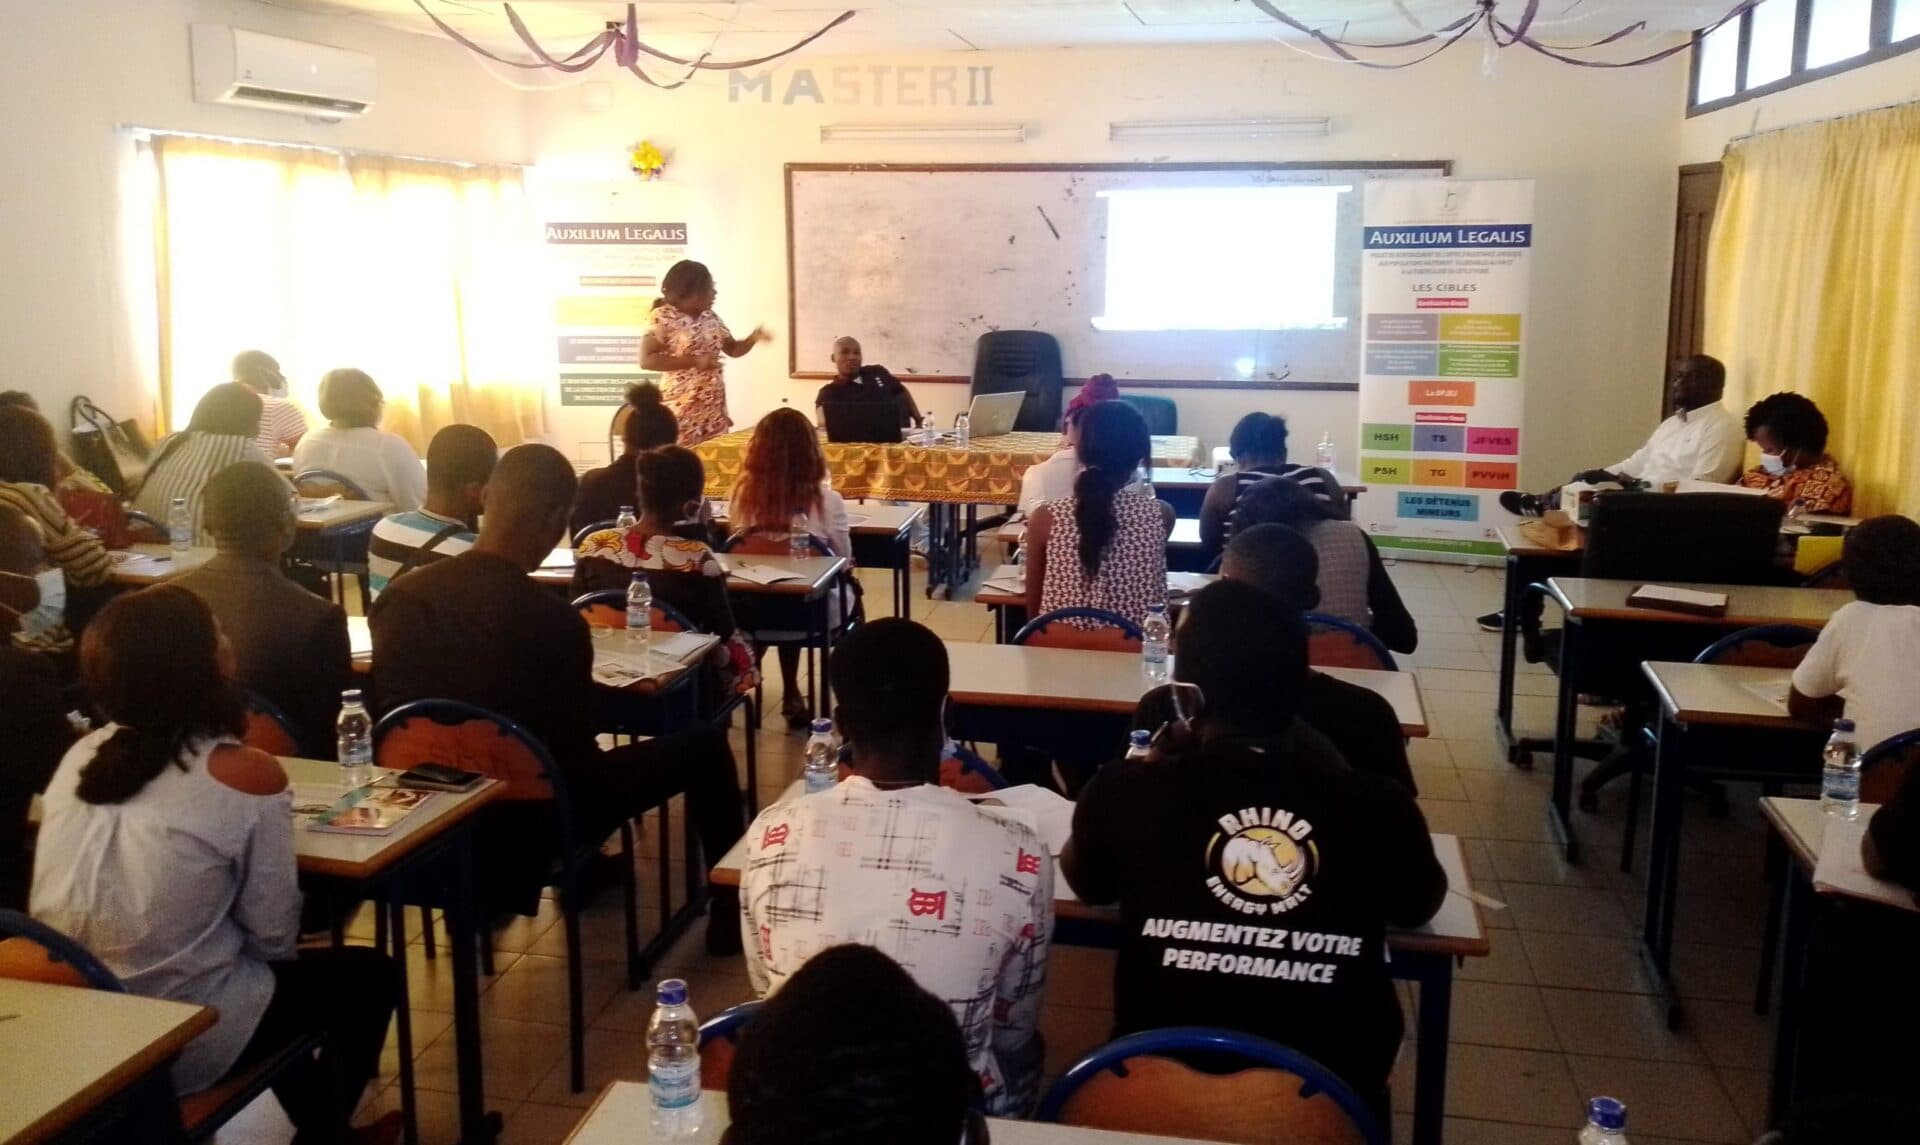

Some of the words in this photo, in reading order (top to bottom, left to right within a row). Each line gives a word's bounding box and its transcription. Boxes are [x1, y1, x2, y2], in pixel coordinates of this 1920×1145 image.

[728, 65, 957, 106] MASTER
[545, 227, 620, 240] AUXILIUM
[624, 227, 685, 240] LEGALIS
[1369, 230, 1452, 245] AUXILIUM
[1457, 229, 1525, 244] LEGALIS
[1412, 284, 1432, 292] LES
[1436, 283, 1477, 292] CIBLES
[1374, 432, 1399, 442] HSH
[1373, 466, 1398, 476] PSH
[1217, 806, 1313, 841] RHINO
[1205, 875, 1267, 915] ENERGY
[1271, 883, 1313, 915] MALT
[1141, 918, 1288, 949] AUGMENTEZ
[1291, 931, 1363, 957] VOTRE
[1162, 948, 1338, 984] PERFORMANCE
